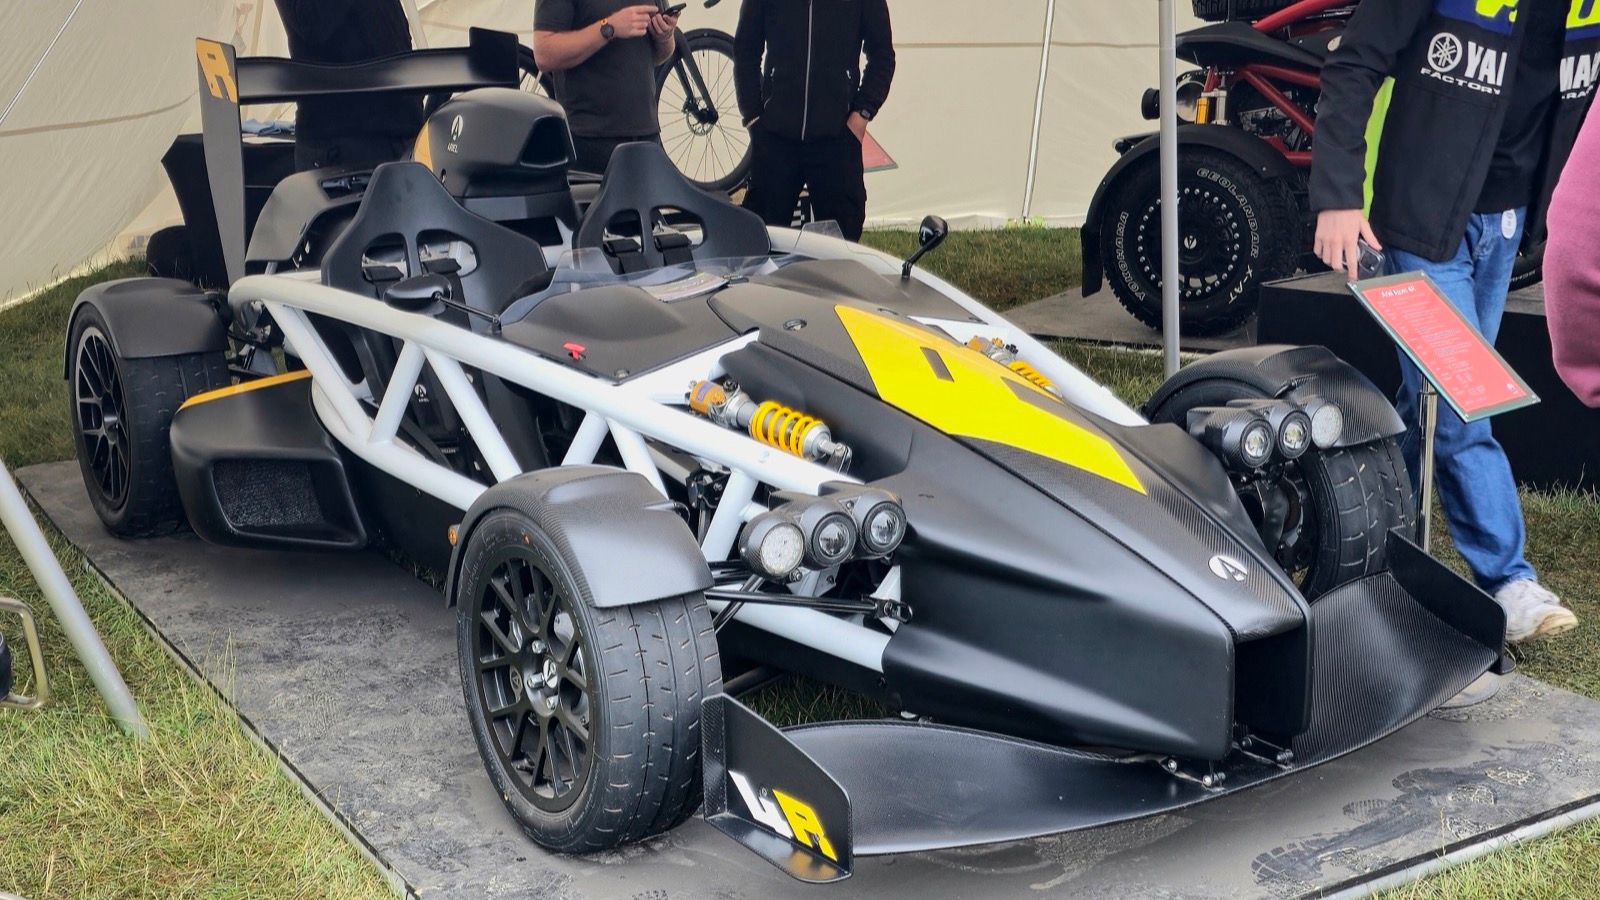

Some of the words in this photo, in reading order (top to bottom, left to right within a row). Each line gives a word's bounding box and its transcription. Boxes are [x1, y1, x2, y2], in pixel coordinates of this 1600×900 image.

[1420, 67, 1501, 95] FACTORY
[1115, 211, 1146, 301] YOKOHAMA
[1197, 167, 1260, 259] GEOLANDAR
